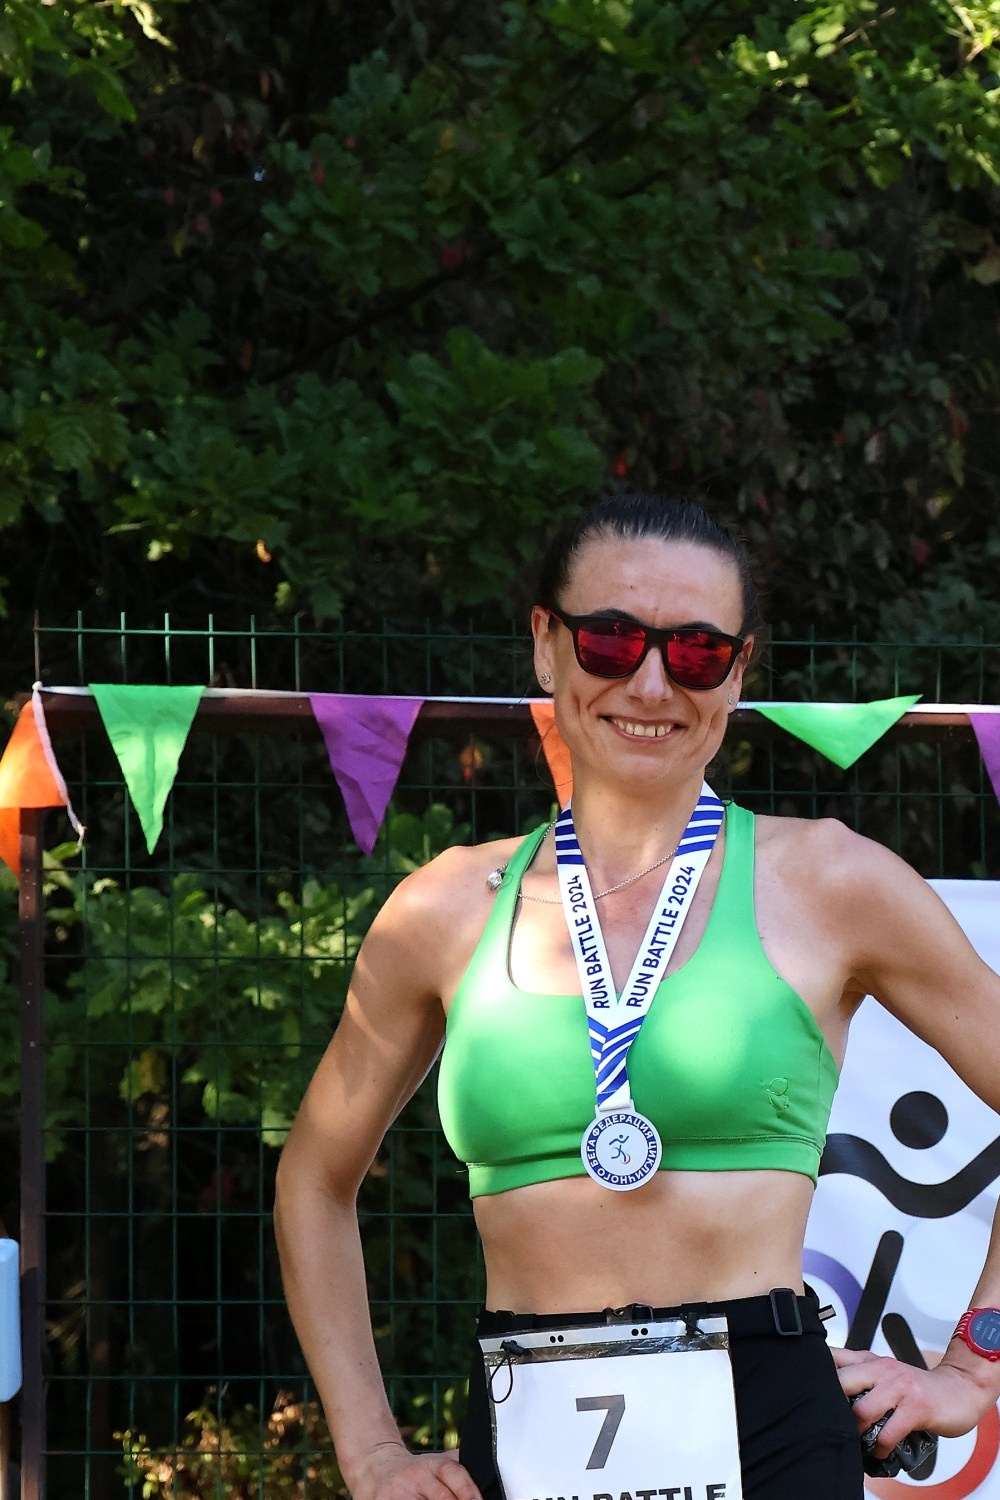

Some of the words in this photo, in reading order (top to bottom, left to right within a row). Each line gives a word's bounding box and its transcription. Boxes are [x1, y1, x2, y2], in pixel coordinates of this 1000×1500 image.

[567, 875, 587, 913] 2024
[575, 914, 603, 976] BATTLE
[626, 972, 654, 1008] RUN
[642, 908, 680, 969] BATTLE
[668, 866, 696, 906] 2024
[589, 978, 610, 1009] RUN
[592, 1114, 654, 1139] ФЕДЕРАЦИЯ
[586, 1139, 599, 1167] БЕГА
[597, 1141, 657, 1185] ЦИКЛИЧНОГО
[575, 1394, 626, 1471] 7
